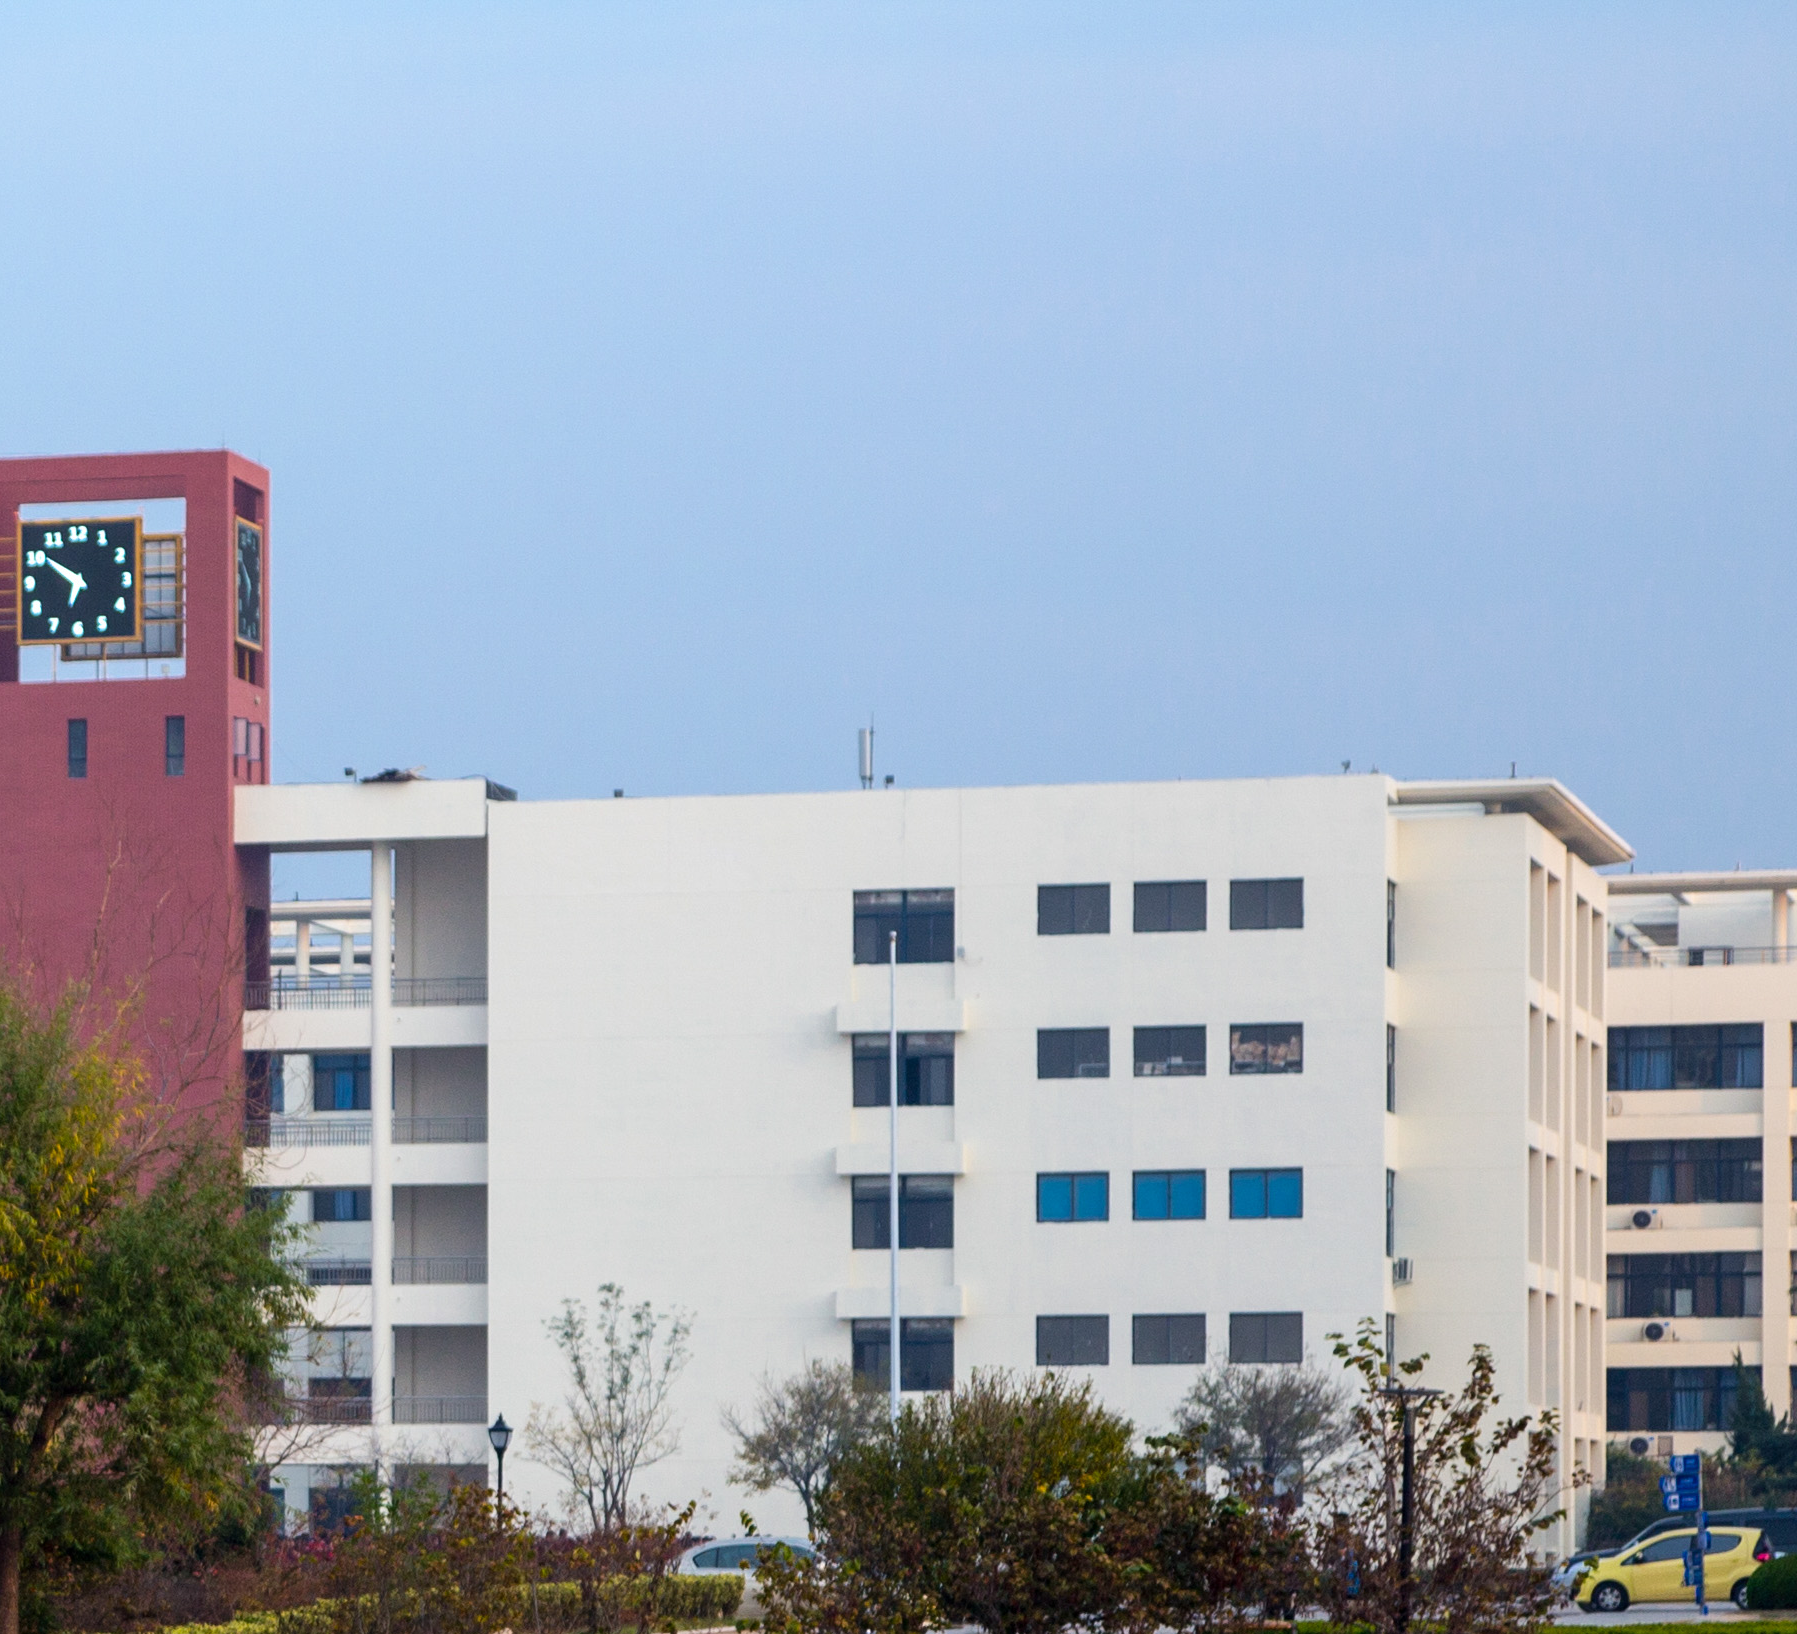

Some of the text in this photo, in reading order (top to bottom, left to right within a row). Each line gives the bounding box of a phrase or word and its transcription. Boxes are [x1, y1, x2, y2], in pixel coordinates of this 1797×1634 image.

[43, 531, 64, 549] 11
[68, 525, 88, 543] 12
[96, 529, 108, 547] 1
[26, 550, 46, 568] 10
[113, 546, 126, 564] 2
[23, 575, 36, 593] 9
[121, 571, 133, 589] 3
[29, 599, 42, 617] 8
[113, 596, 126, 614] 4
[47, 617, 60, 635] 7
[71, 621, 84, 638] 6
[96, 615, 108, 633] 5
